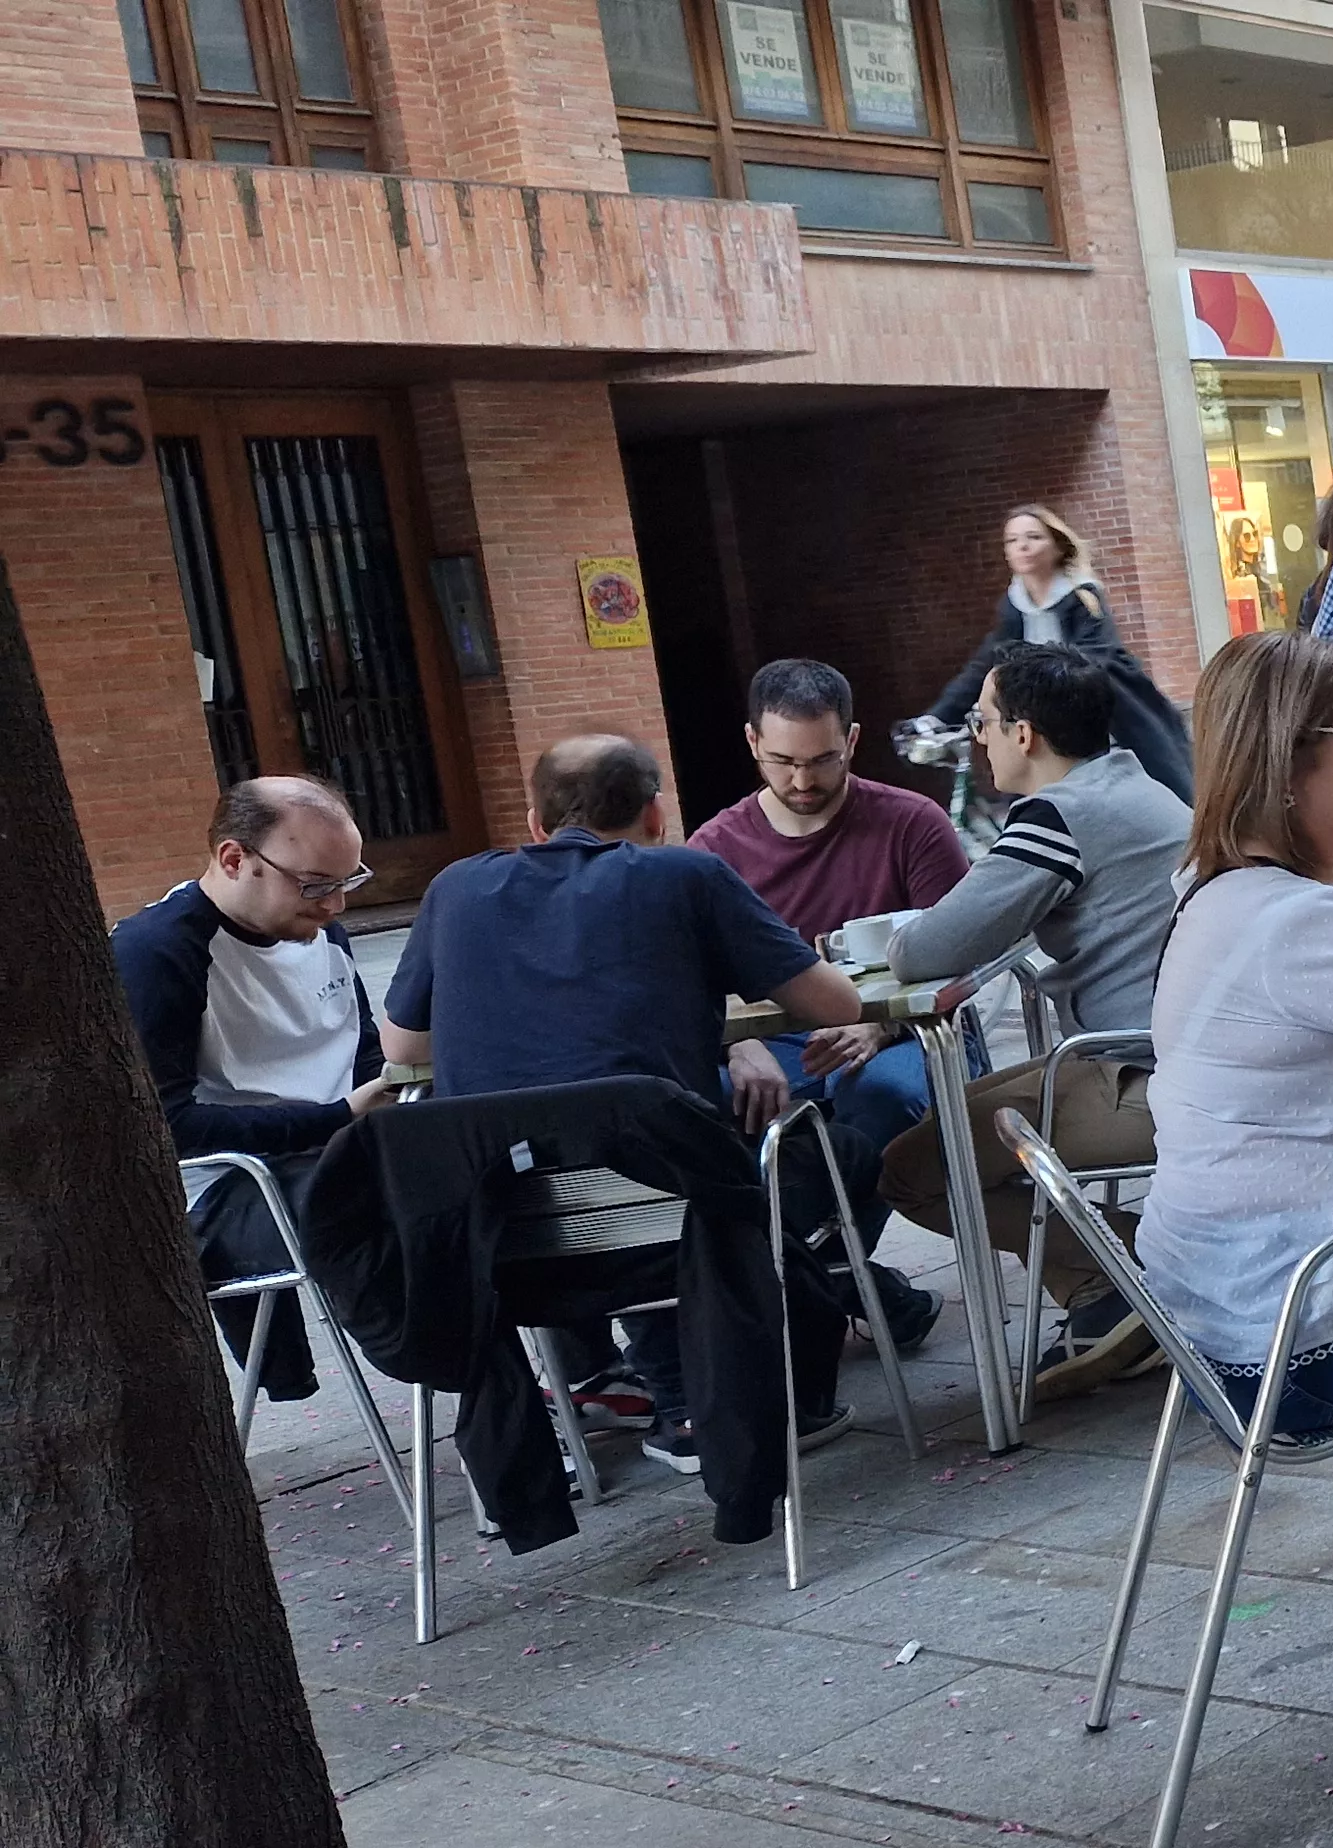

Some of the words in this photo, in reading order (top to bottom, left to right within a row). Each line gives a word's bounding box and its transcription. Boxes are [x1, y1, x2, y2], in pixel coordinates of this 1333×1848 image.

[755, 36, 777, 51] SE
[740, 51, 798, 72] VENDE
[867, 52, 888, 66] SE
[0, 397, 145, 467] -35
